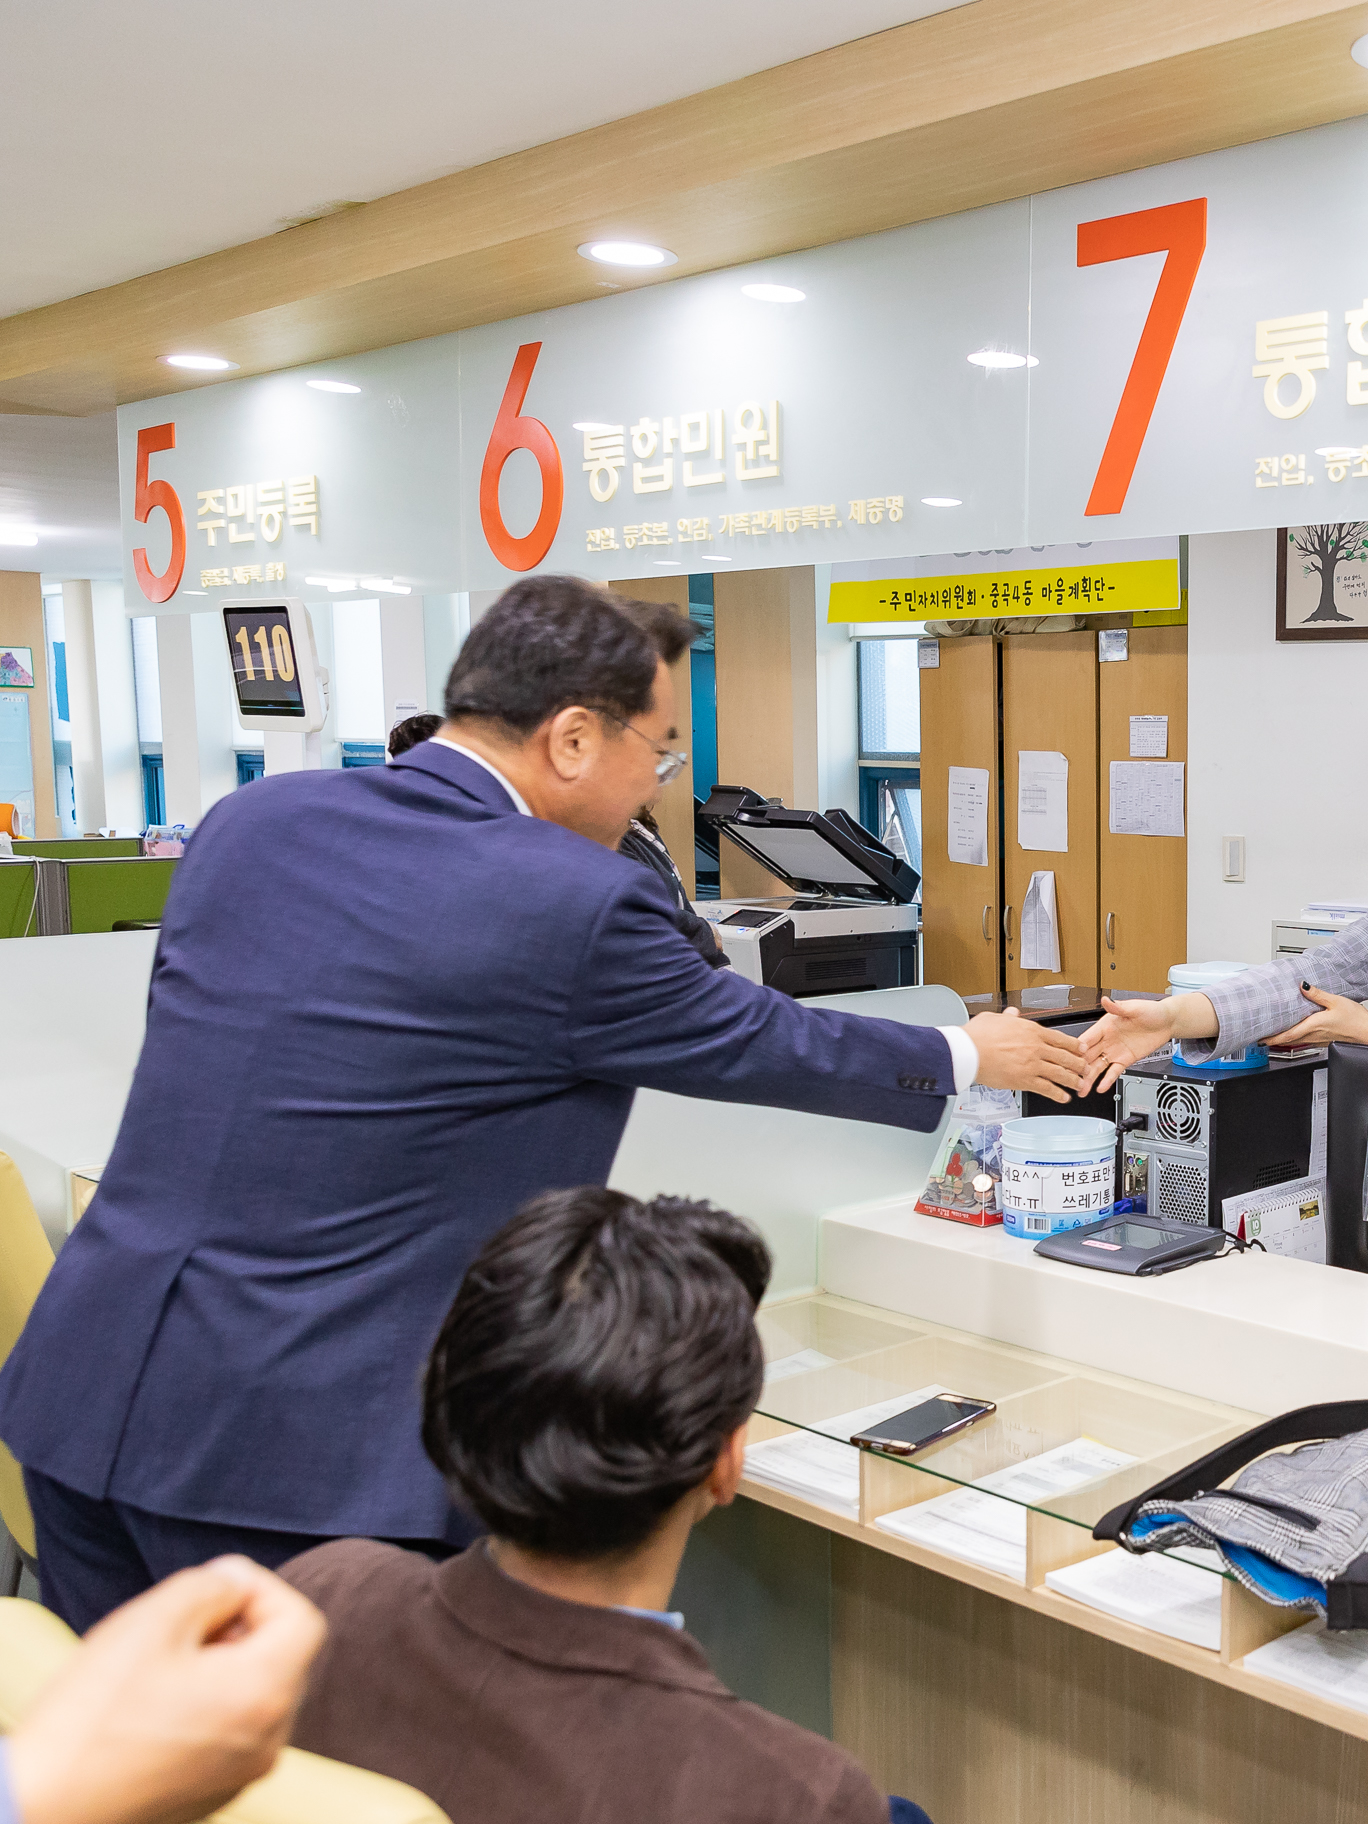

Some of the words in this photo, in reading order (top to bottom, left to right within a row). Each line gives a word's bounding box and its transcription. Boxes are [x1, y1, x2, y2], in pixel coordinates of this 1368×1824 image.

[1076, 197, 1208, 517] 7
[480, 341, 563, 571] 6
[582, 399, 782, 502] 통합민원
[1254, 455, 1314, 488] 전입,
[132, 422, 187, 603] 5
[197, 474, 318, 547] 주민등록
[847, 494, 905, 525] 제증명
[235, 624, 295, 682] 110
[1061, 1166, 1111, 1187] 번호표만
[1061, 1188, 1111, 1210] 쓰레기통
